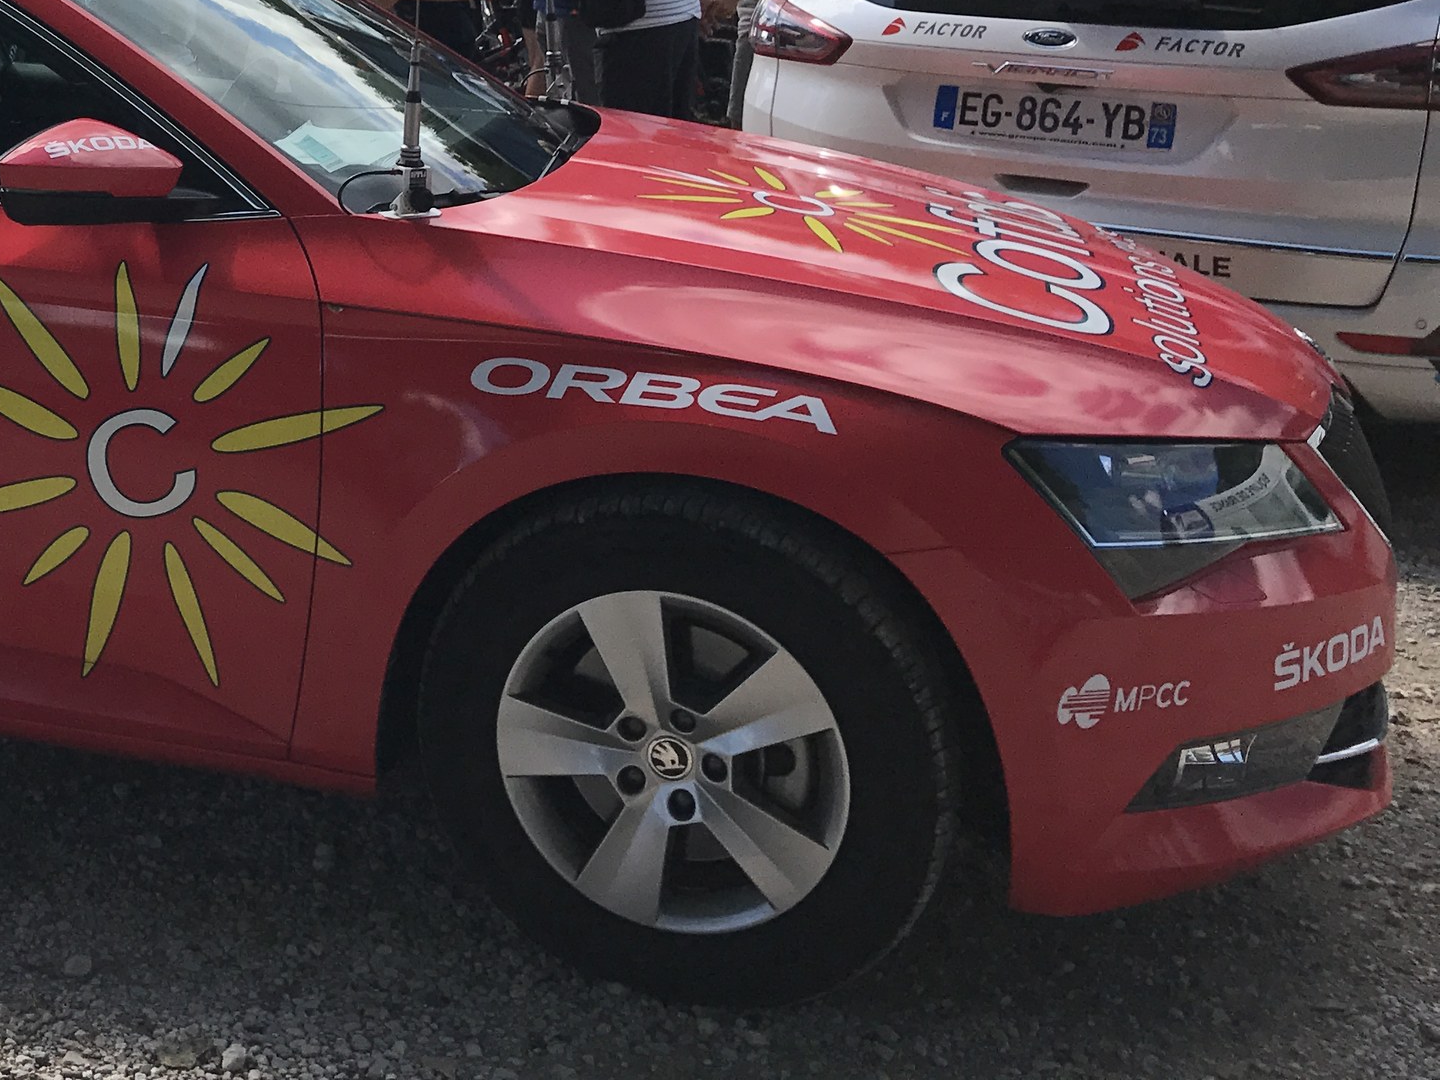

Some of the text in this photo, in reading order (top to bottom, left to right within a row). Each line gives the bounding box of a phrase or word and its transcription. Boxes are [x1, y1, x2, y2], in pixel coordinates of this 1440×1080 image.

[913, 21, 987, 39] FACTOR
[1155, 36, 1245, 58] FACTOR
[959, 91, 1146, 141] EG-864-YB
[1150, 126, 1167, 144] 73
[470, 357, 838, 436] ORBEA
[1274, 615, 1386, 691] ŠKODA
[1114, 680, 1191, 713] MPCC
